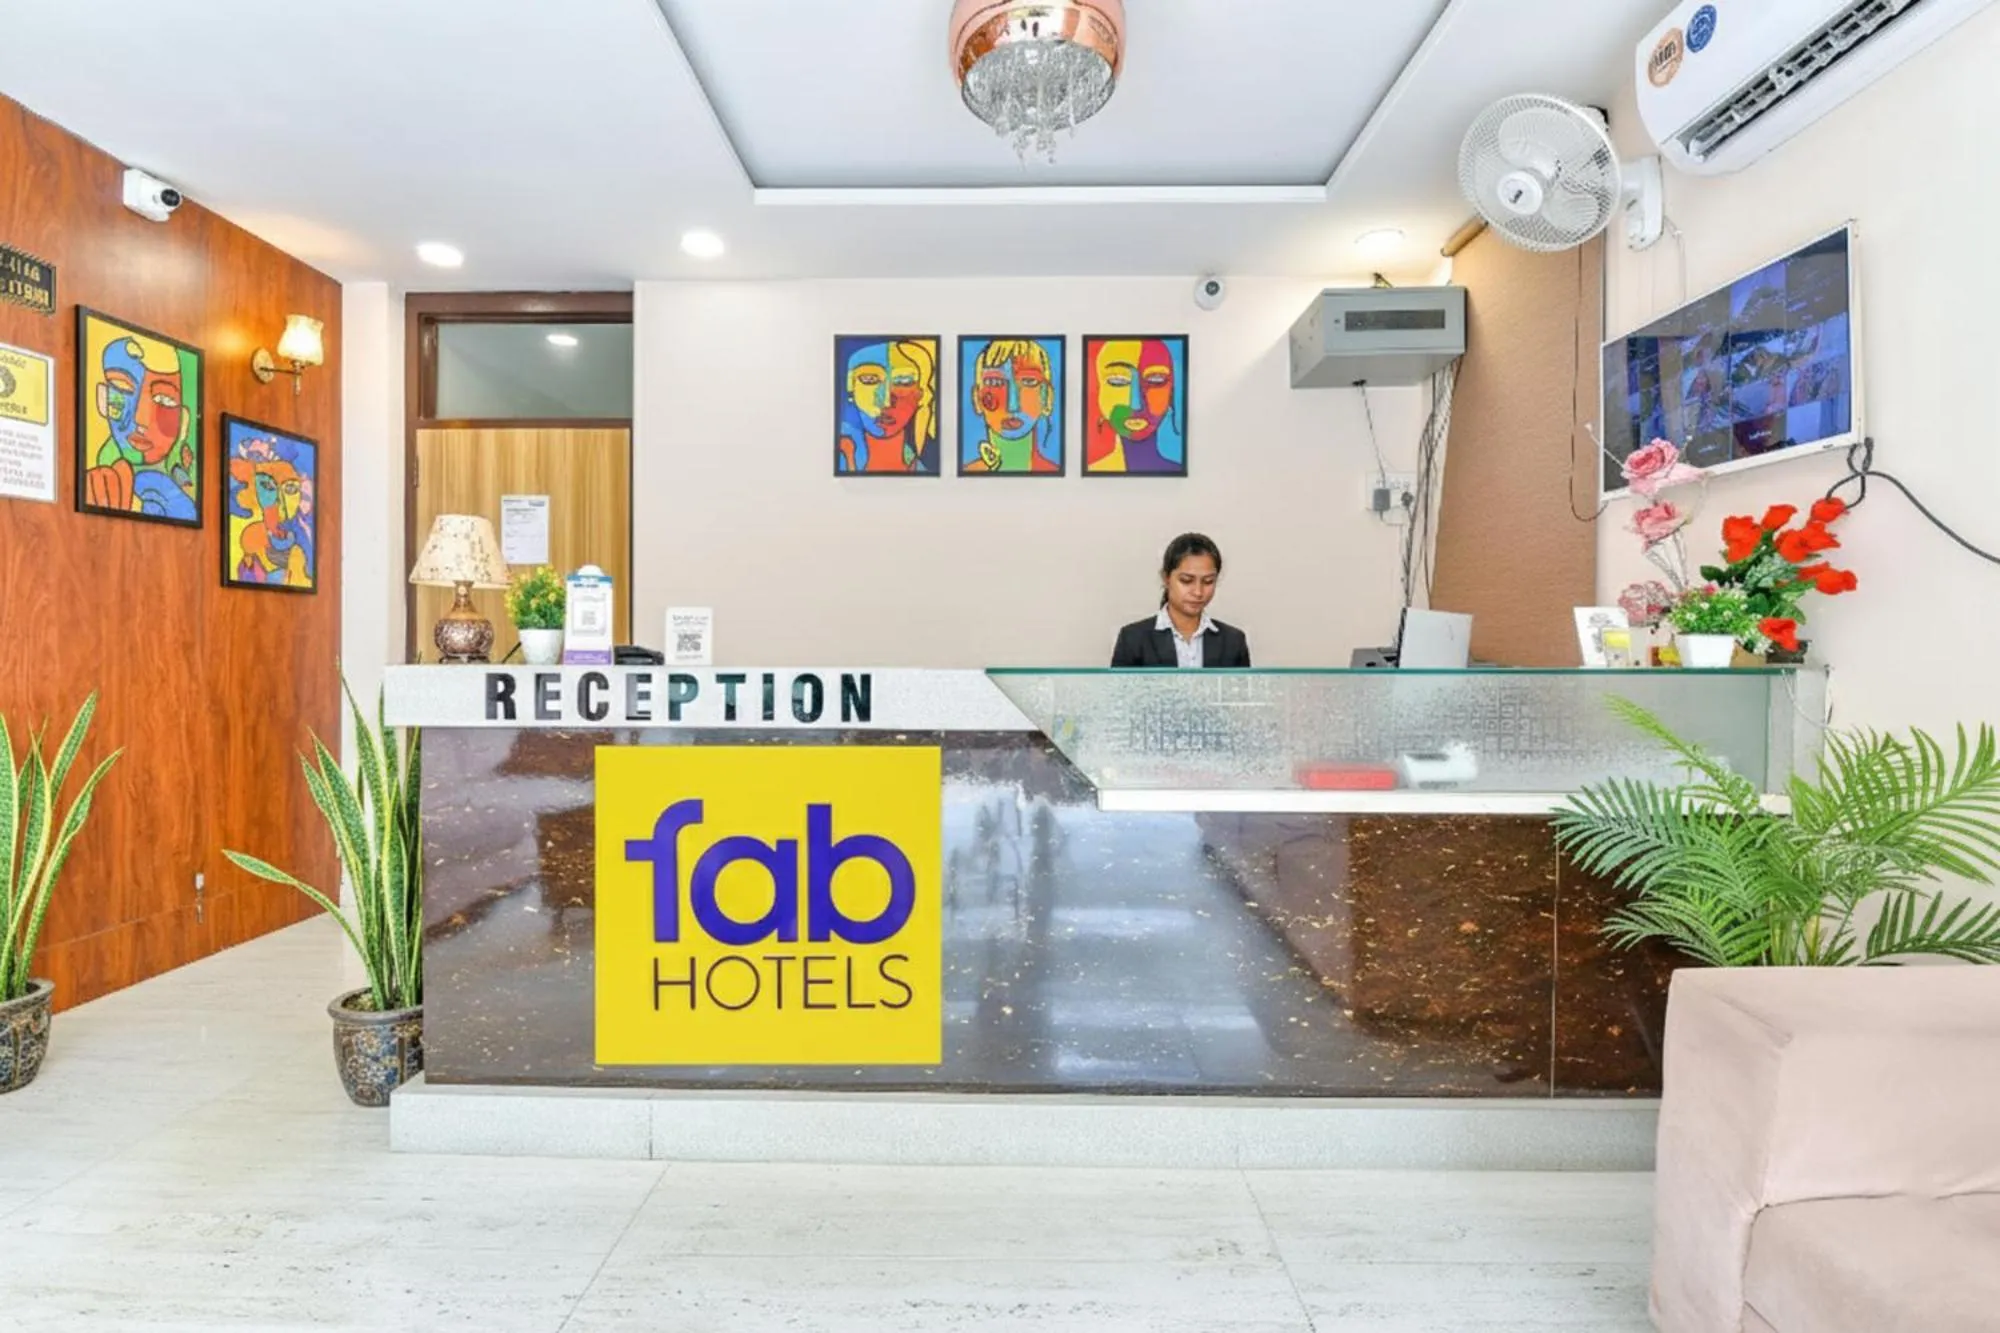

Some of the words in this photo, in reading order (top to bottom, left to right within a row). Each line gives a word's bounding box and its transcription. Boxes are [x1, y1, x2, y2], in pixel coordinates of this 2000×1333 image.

[485, 672, 872, 722] RECEPTION
[625, 798, 916, 945] fab
[653, 954, 913, 1011] HOTELS
